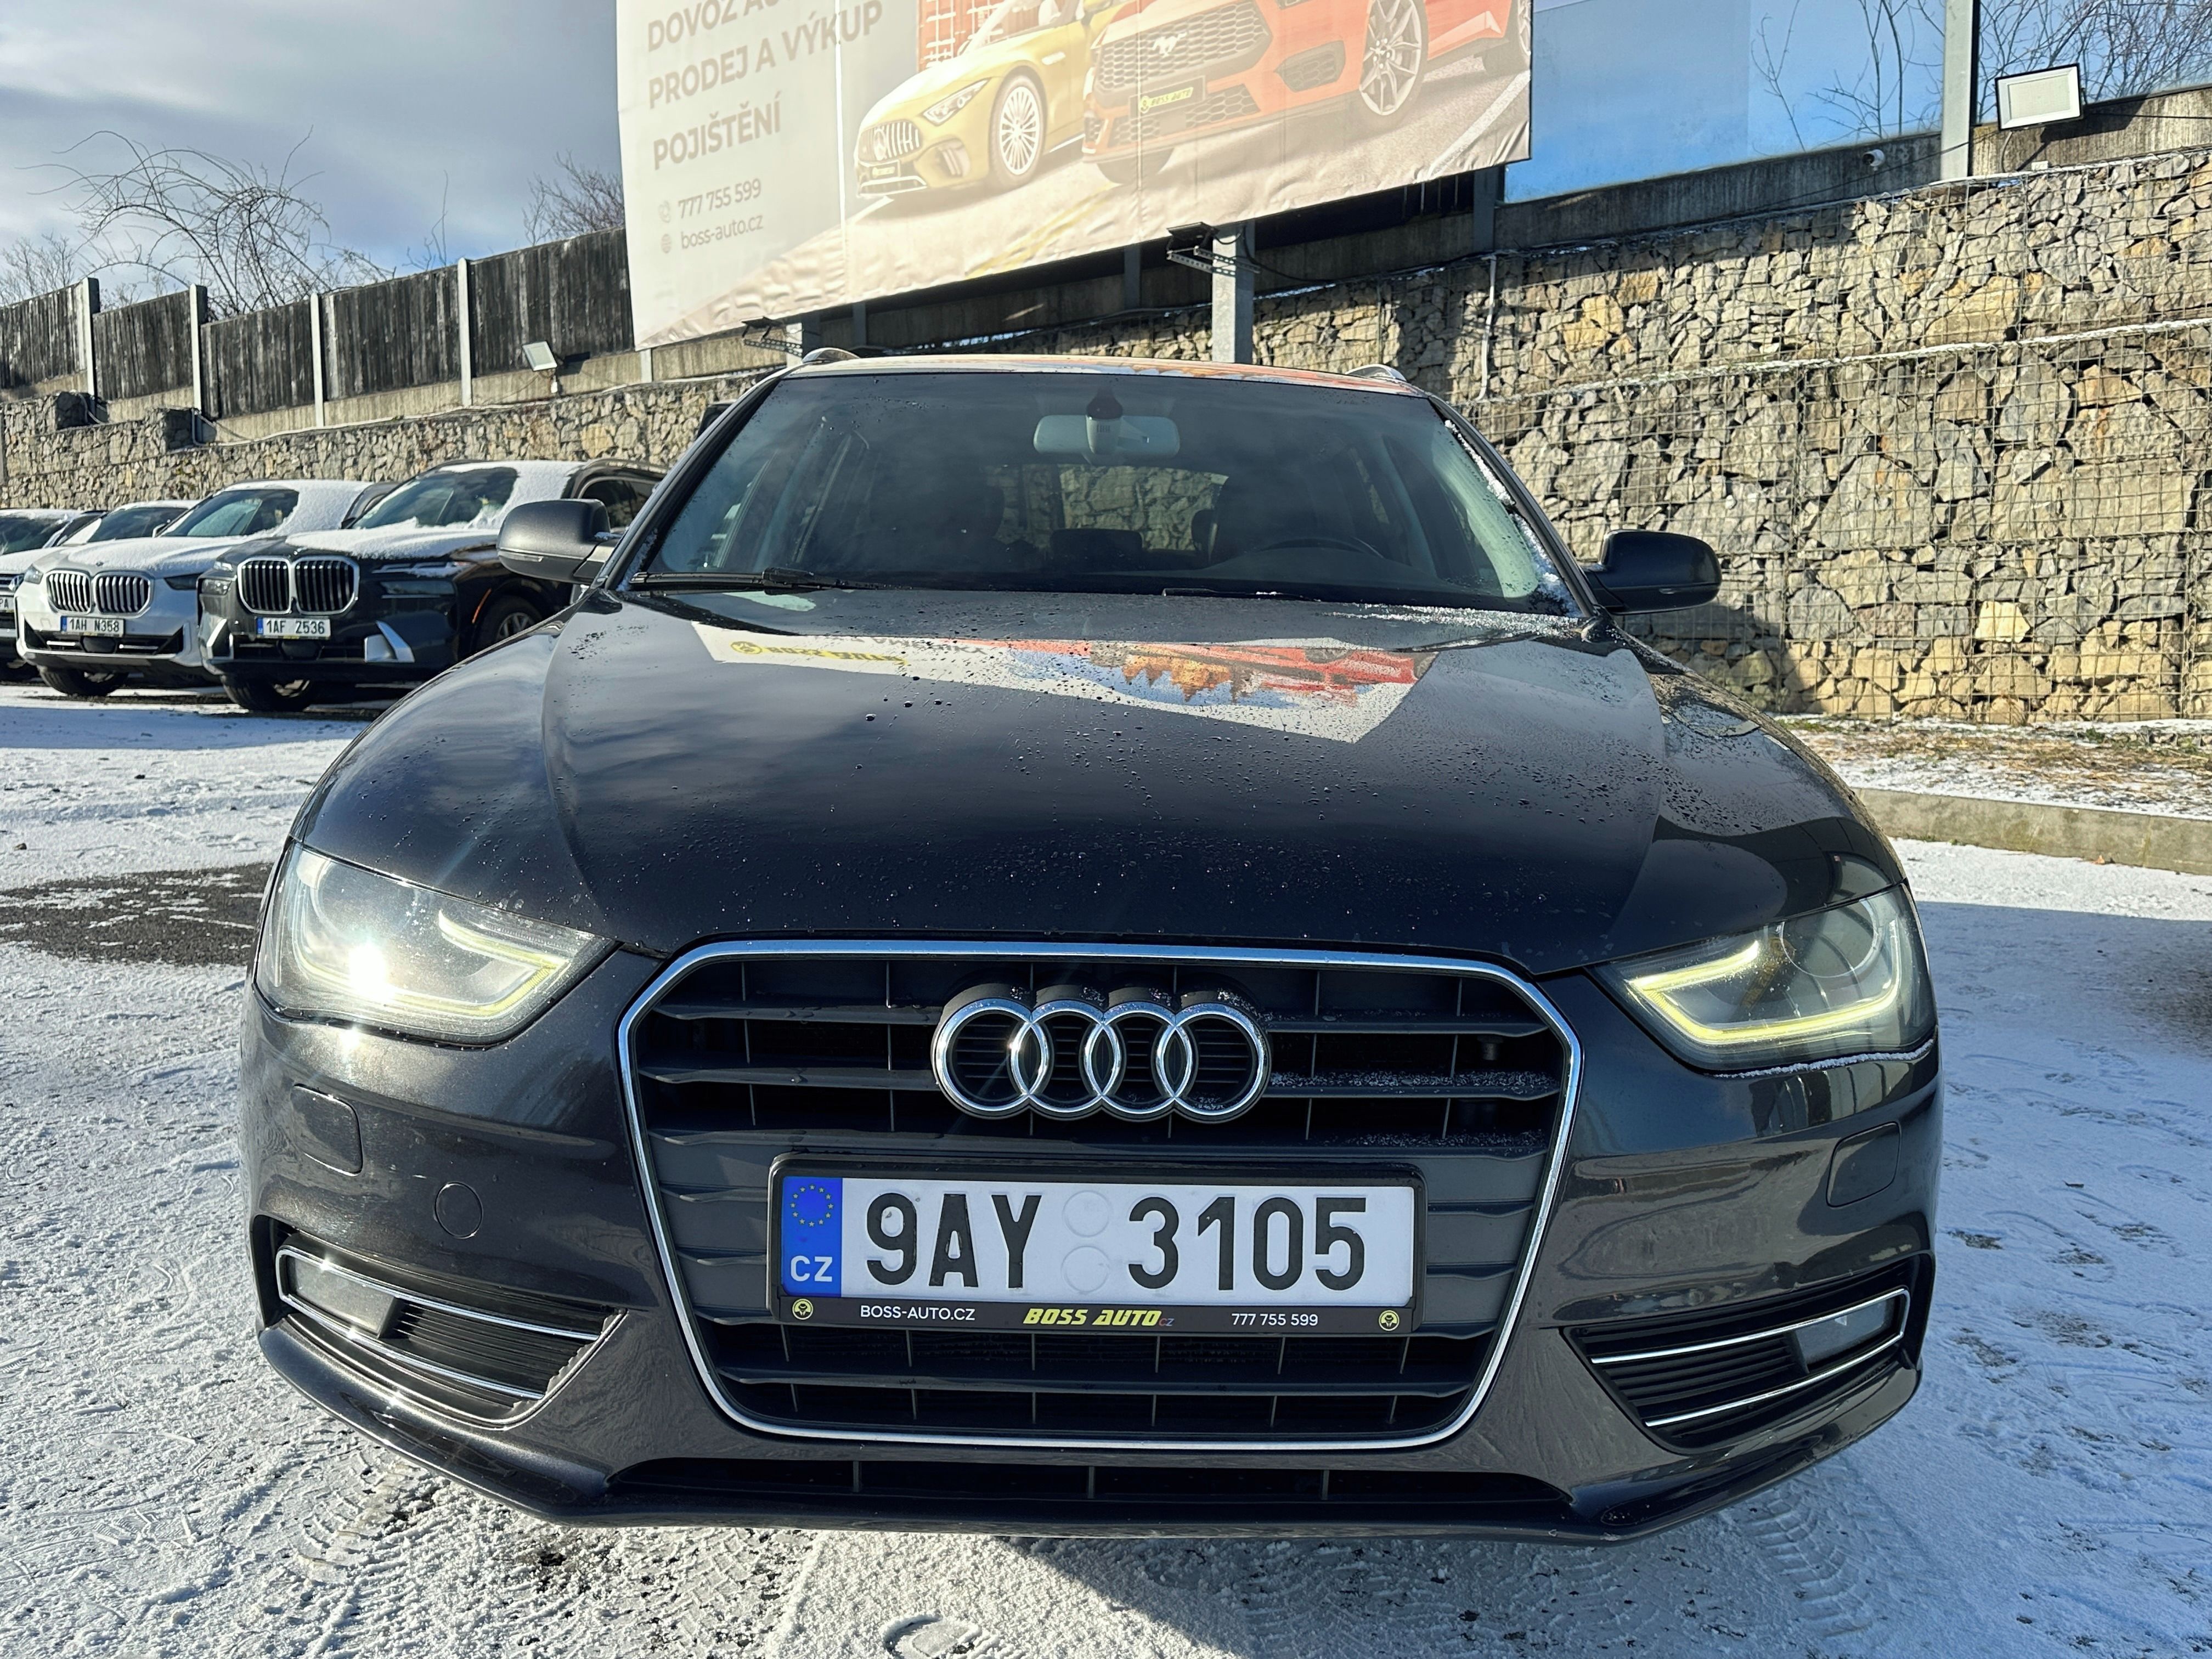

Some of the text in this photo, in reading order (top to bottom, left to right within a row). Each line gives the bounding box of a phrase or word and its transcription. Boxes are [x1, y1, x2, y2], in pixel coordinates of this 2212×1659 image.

[648, 0, 737, 52] DOVOZ
[649, 0, 883, 109] PRODEJ A VÝKUP
[653, 91, 781, 171] POJIŠTĚNÍ
[678, 178, 761, 219] 777 755 599
[681, 215, 764, 249] boss-auto.cz
[70, 618, 87, 630] 1AH
[94, 619, 120, 632] N358
[267, 620, 286, 633] 1AF
[867, 1193, 1366, 1290] 9AY 3105
[791, 1255, 833, 1282] CZ
[860, 1305, 975, 1321] BOSS-AUTO.CZ
[1023, 1308, 1088, 1325] BOSS
[1092, 1310, 1162, 1326] AUTO
[1232, 1313, 1318, 1326] 777 755 599
